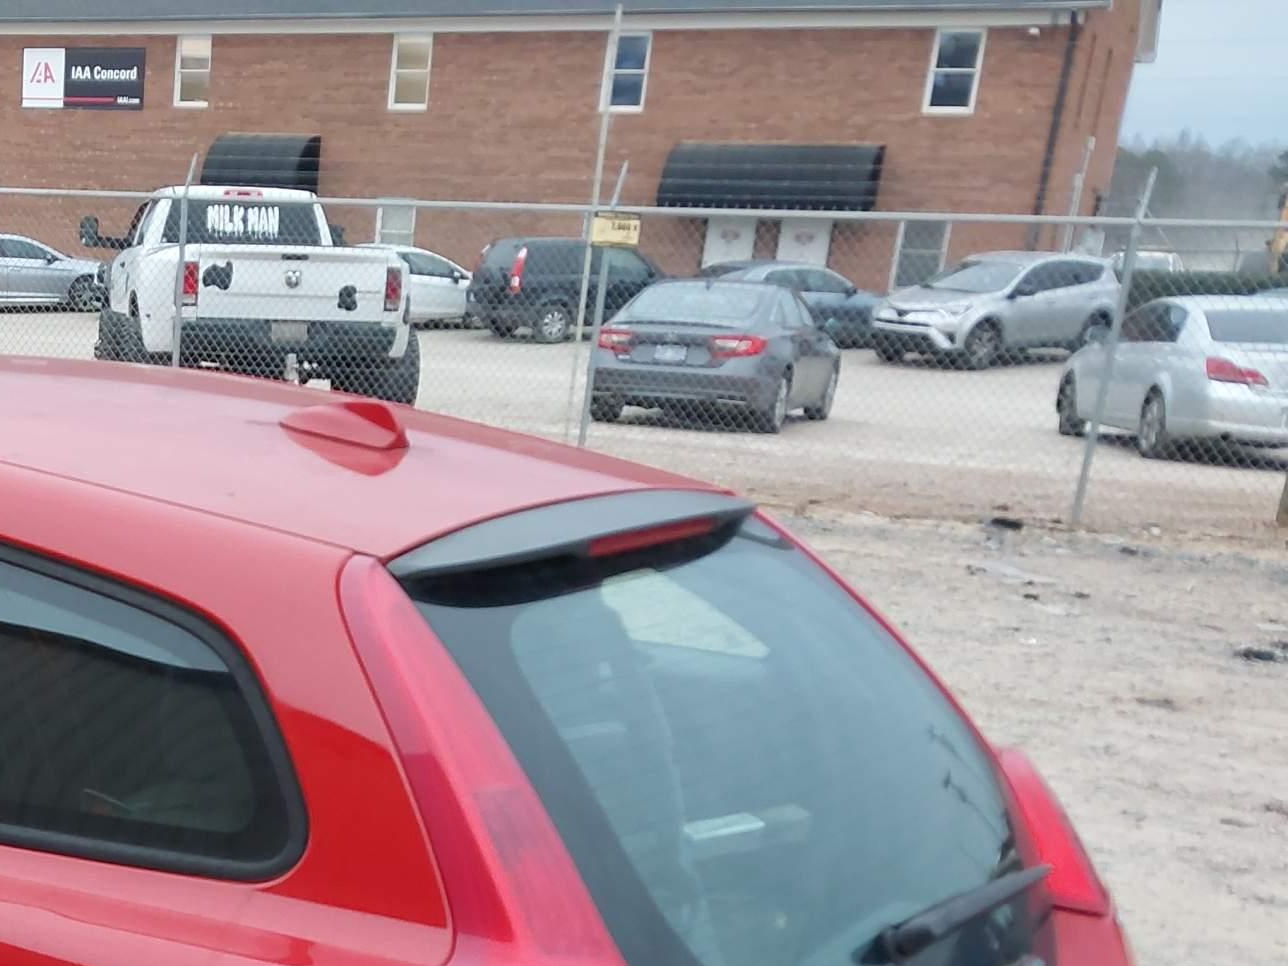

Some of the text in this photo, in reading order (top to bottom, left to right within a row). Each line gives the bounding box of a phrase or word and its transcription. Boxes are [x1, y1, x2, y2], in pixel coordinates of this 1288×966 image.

[71, 65, 138, 80] IAA Concord
[207, 204, 280, 240] MILK MAN
